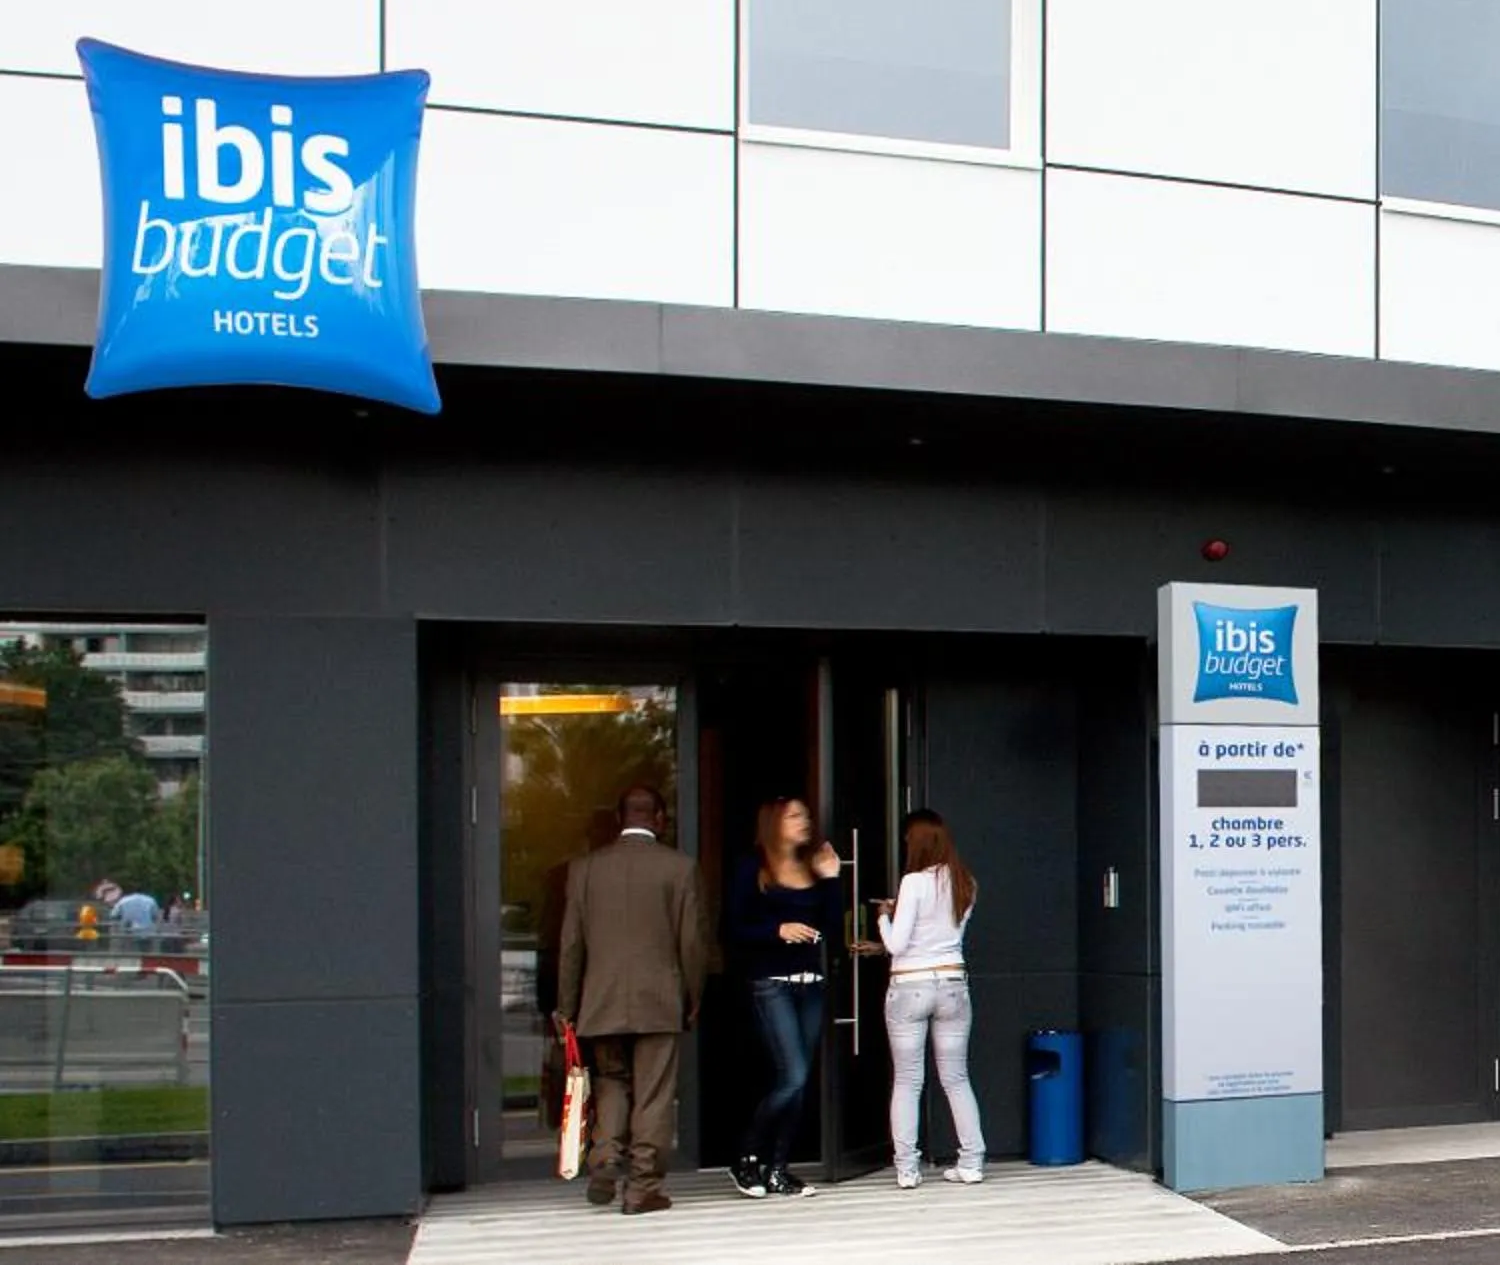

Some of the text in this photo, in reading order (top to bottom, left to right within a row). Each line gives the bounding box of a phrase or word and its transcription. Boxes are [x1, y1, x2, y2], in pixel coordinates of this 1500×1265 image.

[161, 96, 354, 216] ibis
[132, 200, 388, 301] budget
[213, 310, 320, 338] HOTELS
[1215, 619, 1276, 654] ibis
[1205, 651, 1288, 680] budget
[1228, 682, 1264, 692] HOTELS
[1215, 741, 1268, 760] partir
[1211, 816, 1284, 831] chambre
[1188, 833, 1307, 851] 1, 2 ou 3 pers.
